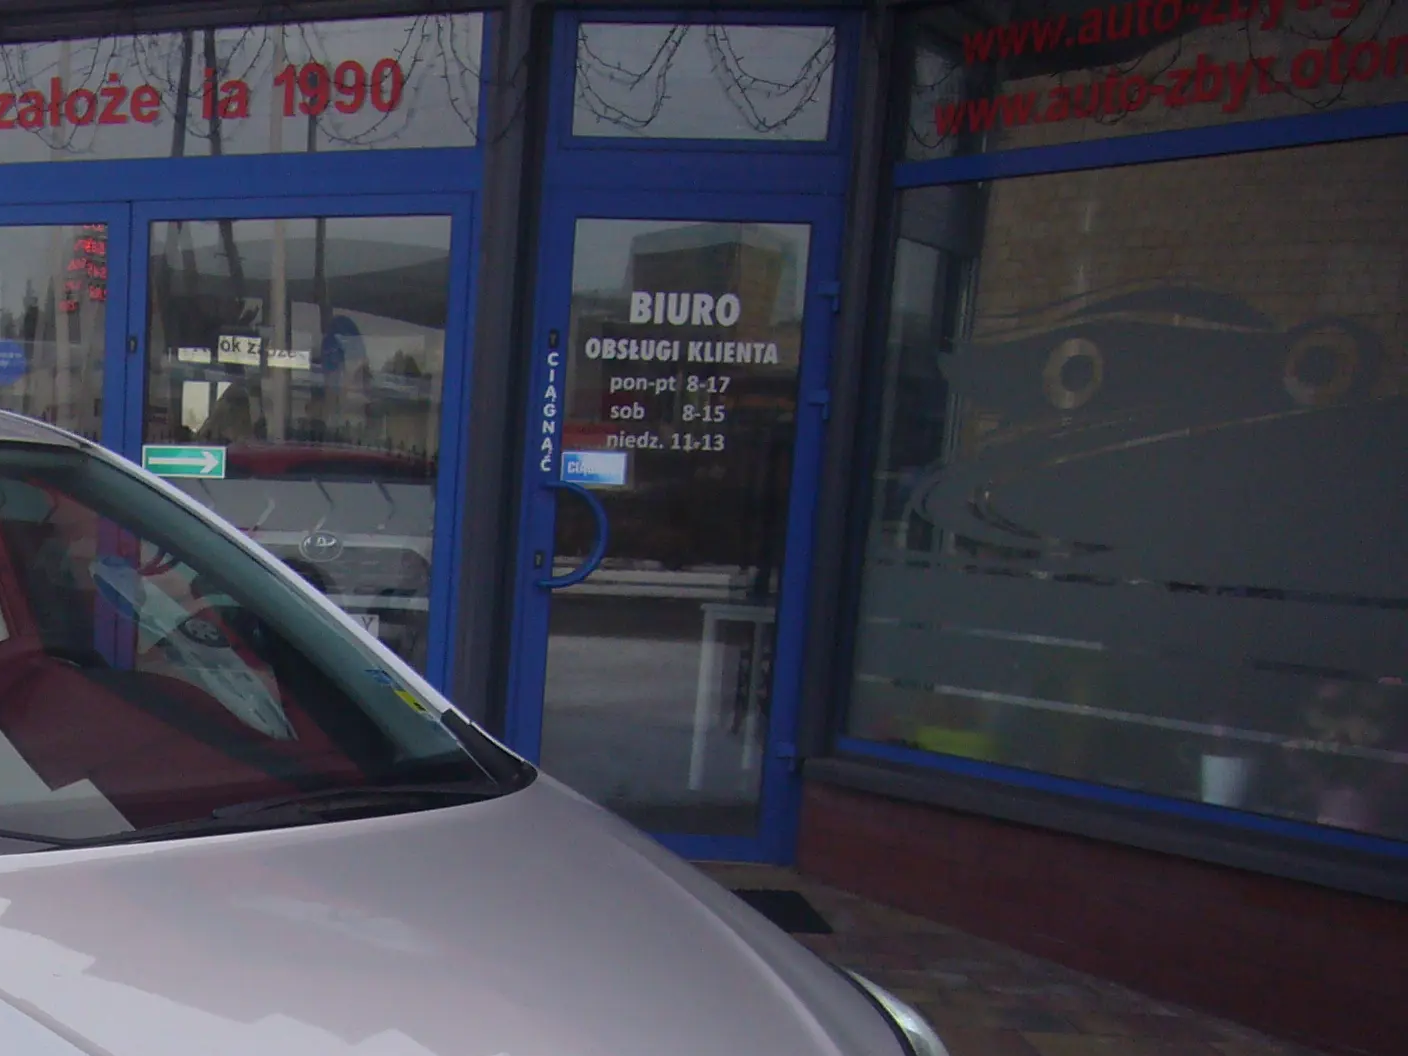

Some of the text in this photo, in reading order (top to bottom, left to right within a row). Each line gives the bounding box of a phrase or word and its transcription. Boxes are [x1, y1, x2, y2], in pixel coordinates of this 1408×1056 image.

[274, 58, 402, 117] 1990
[629, 291, 741, 327] BIURO
[585, 337, 779, 364] OBSŁUGI KLIENTA
[609, 375, 731, 395] pon-pt 8-17
[610, 401, 726, 422] sob 8-15
[606, 430, 725, 451] niedz. 11-13
